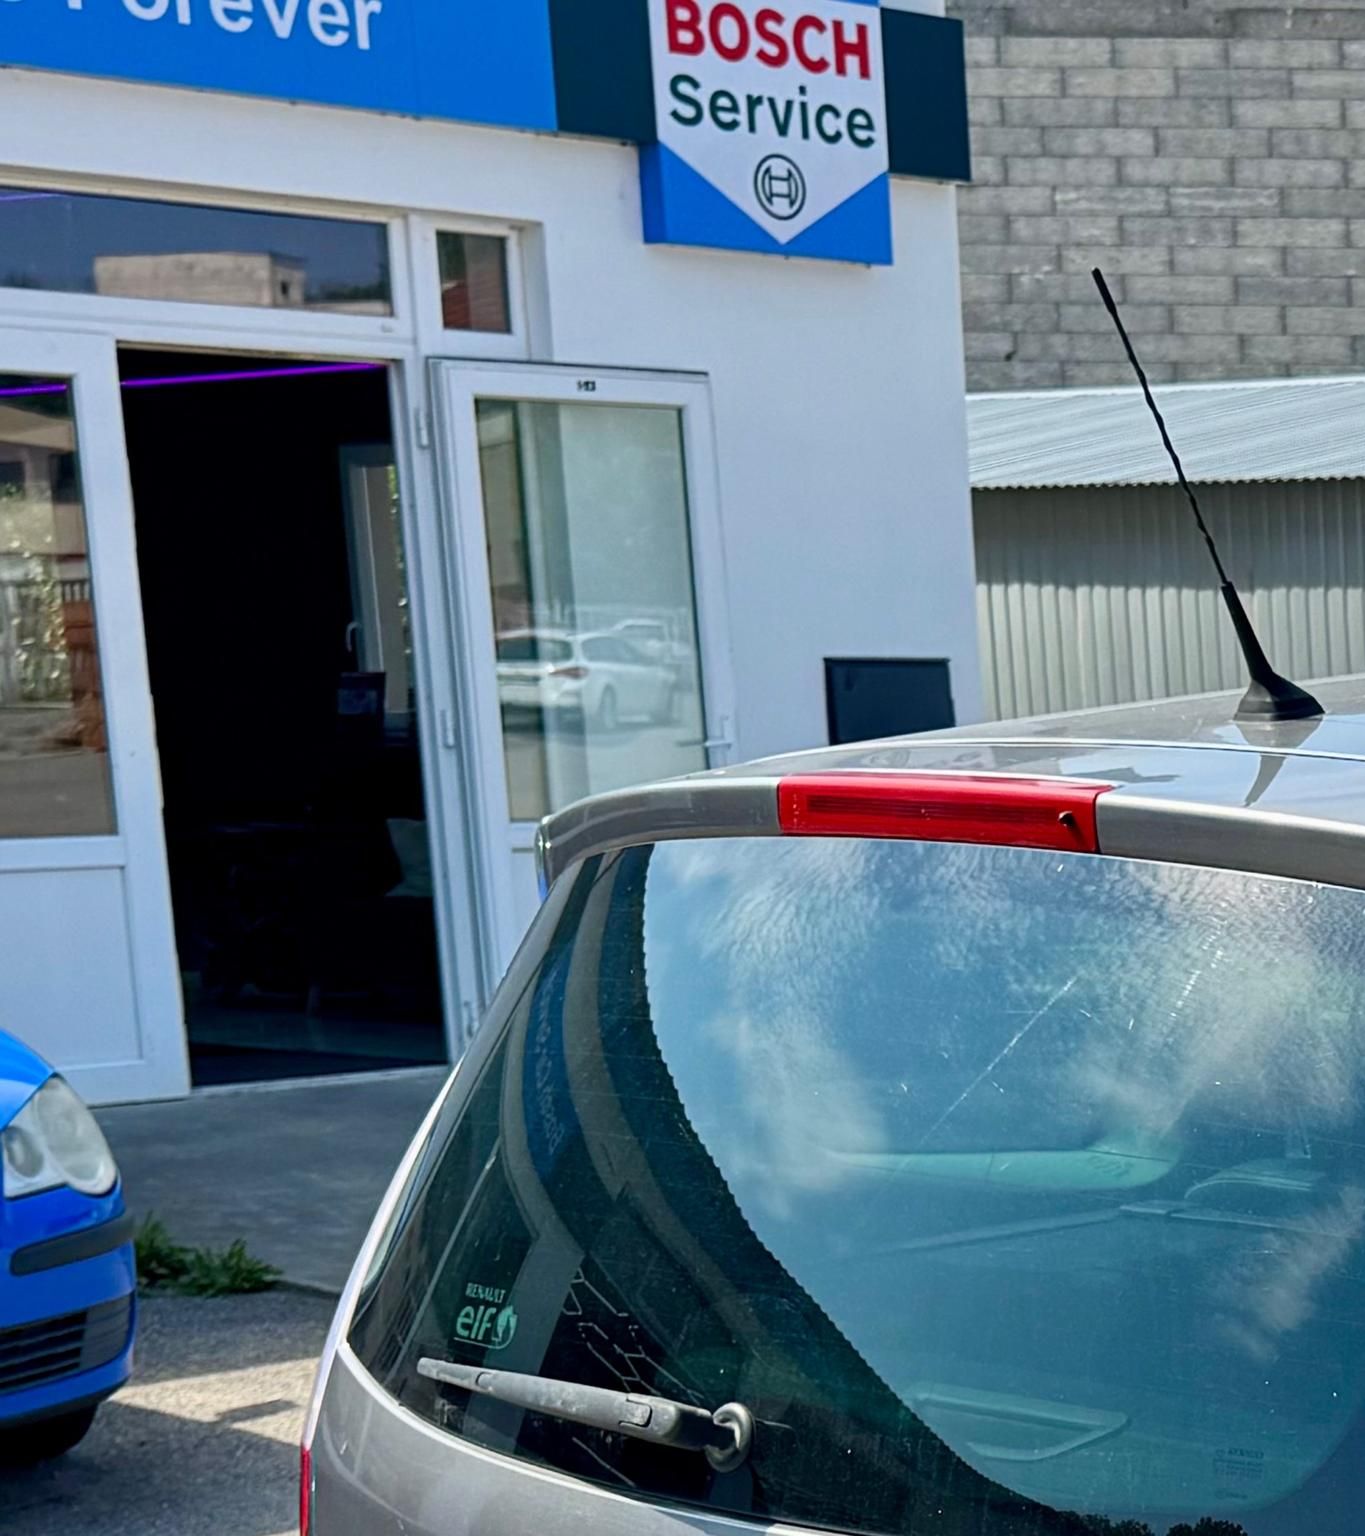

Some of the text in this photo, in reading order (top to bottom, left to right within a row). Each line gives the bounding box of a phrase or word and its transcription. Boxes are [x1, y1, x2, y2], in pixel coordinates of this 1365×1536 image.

[665, 0, 872, 81] BOSCH
[669, 74, 876, 148] Service
[456, 1305, 497, 1340] elf
